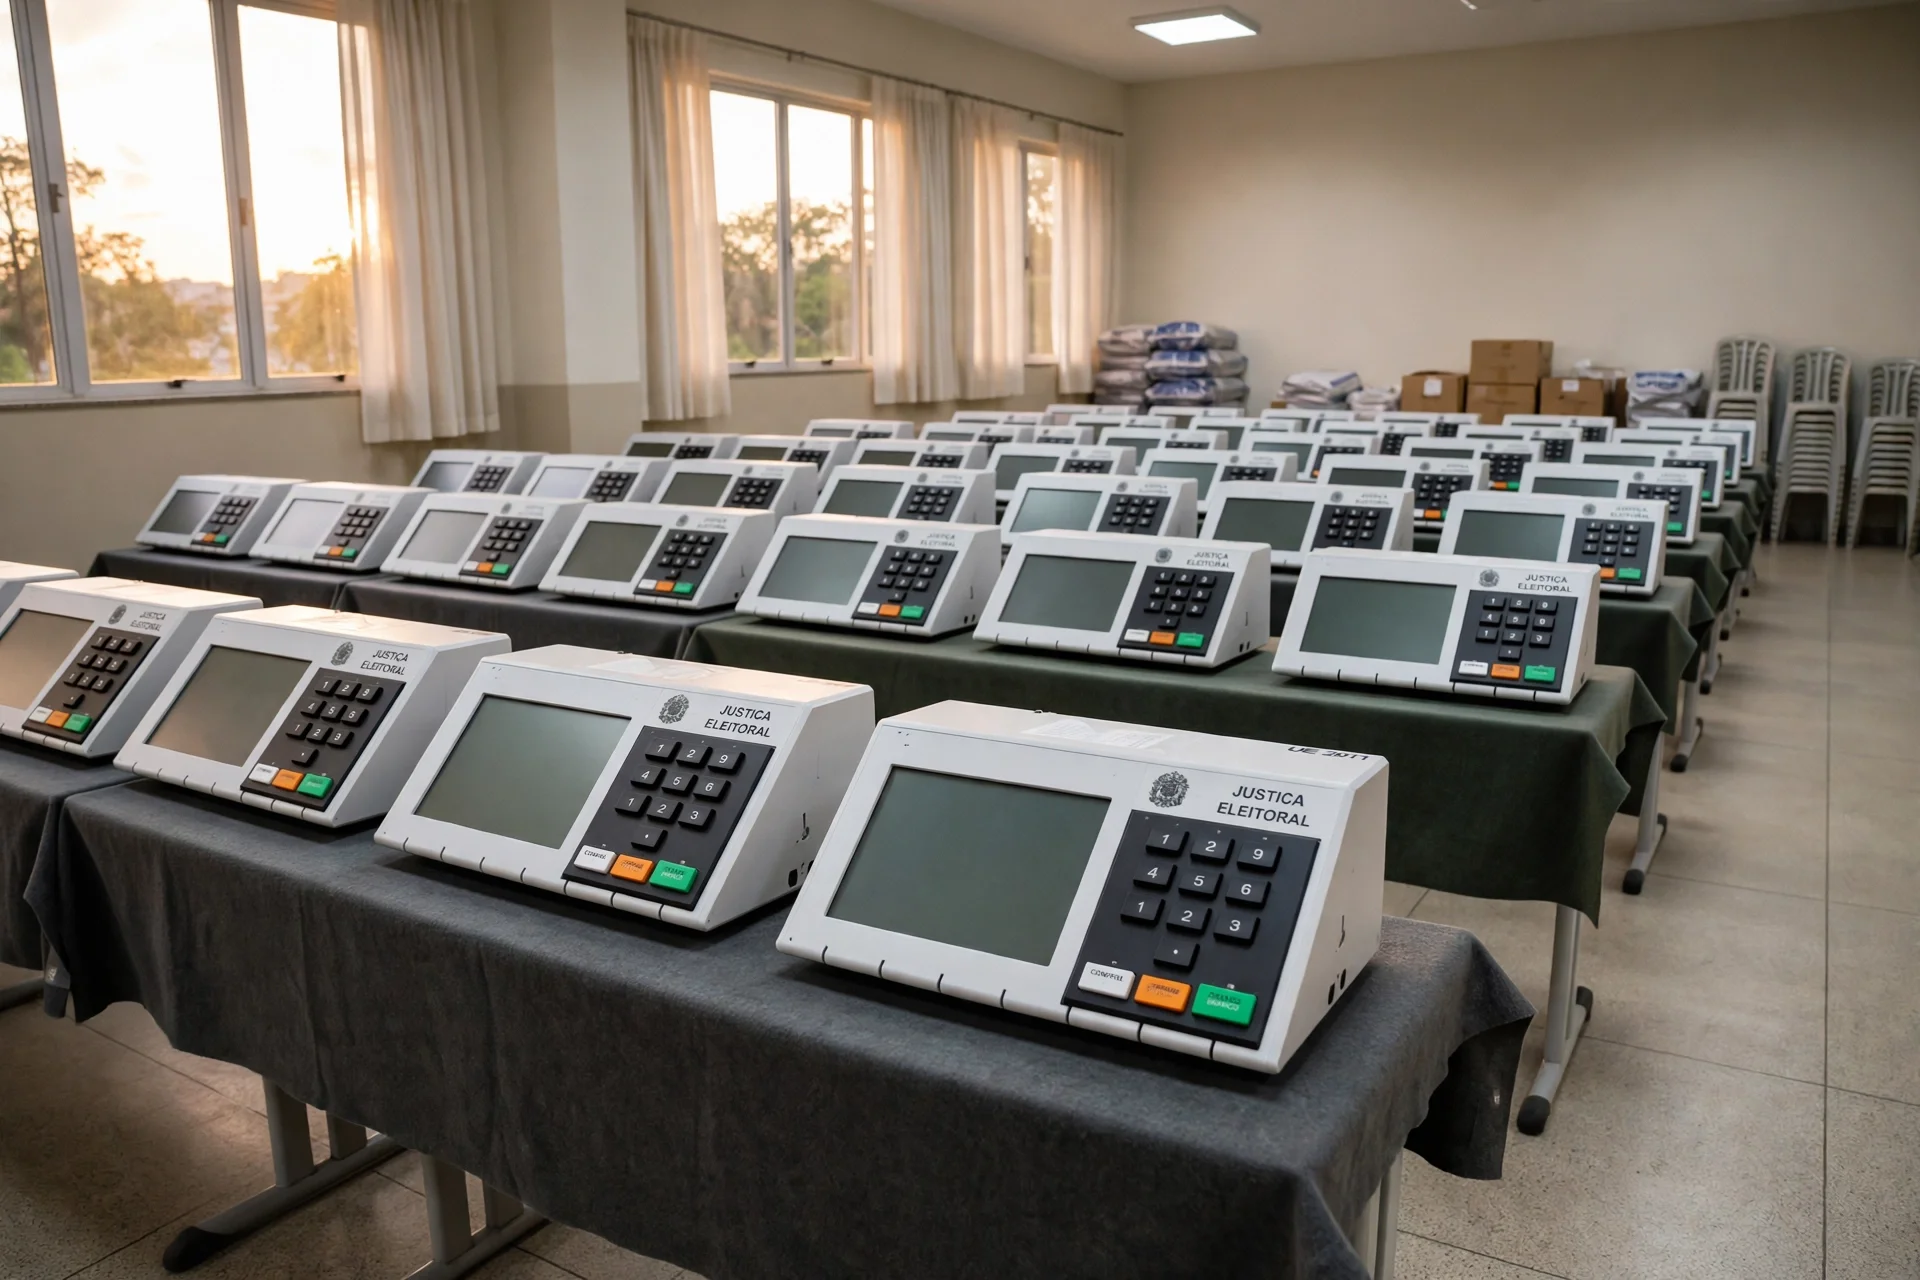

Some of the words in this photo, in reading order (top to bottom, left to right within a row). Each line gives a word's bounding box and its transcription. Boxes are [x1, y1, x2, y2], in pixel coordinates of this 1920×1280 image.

[719, 705, 771, 721] JUSTICA
[704, 718, 771, 738] ELEITORAL
[657, 744, 665, 753] 1
[686, 749, 696, 759] 2
[719, 754, 729, 764] 9
[641, 770, 651, 780] 4
[673, 776, 683, 786] 5
[705, 782, 714, 792] 6
[1232, 786, 1304, 807] JUSTICA
[628, 797, 635, 807] 1
[657, 803, 667, 814] 2
[690, 810, 699, 820] 3
[1216, 802, 1310, 827] ELEITORAL
[1162, 834, 1170, 845] 1
[1205, 840, 1217, 853] 2
[1252, 848, 1264, 861] 9
[1147, 867, 1159, 879] 4
[1193, 875, 1205, 887] 5
[1240, 883, 1252, 896] 6
[1138, 901, 1145, 913] 1
[1181, 909, 1193, 923] 2
[1229, 919, 1241, 932] 3
